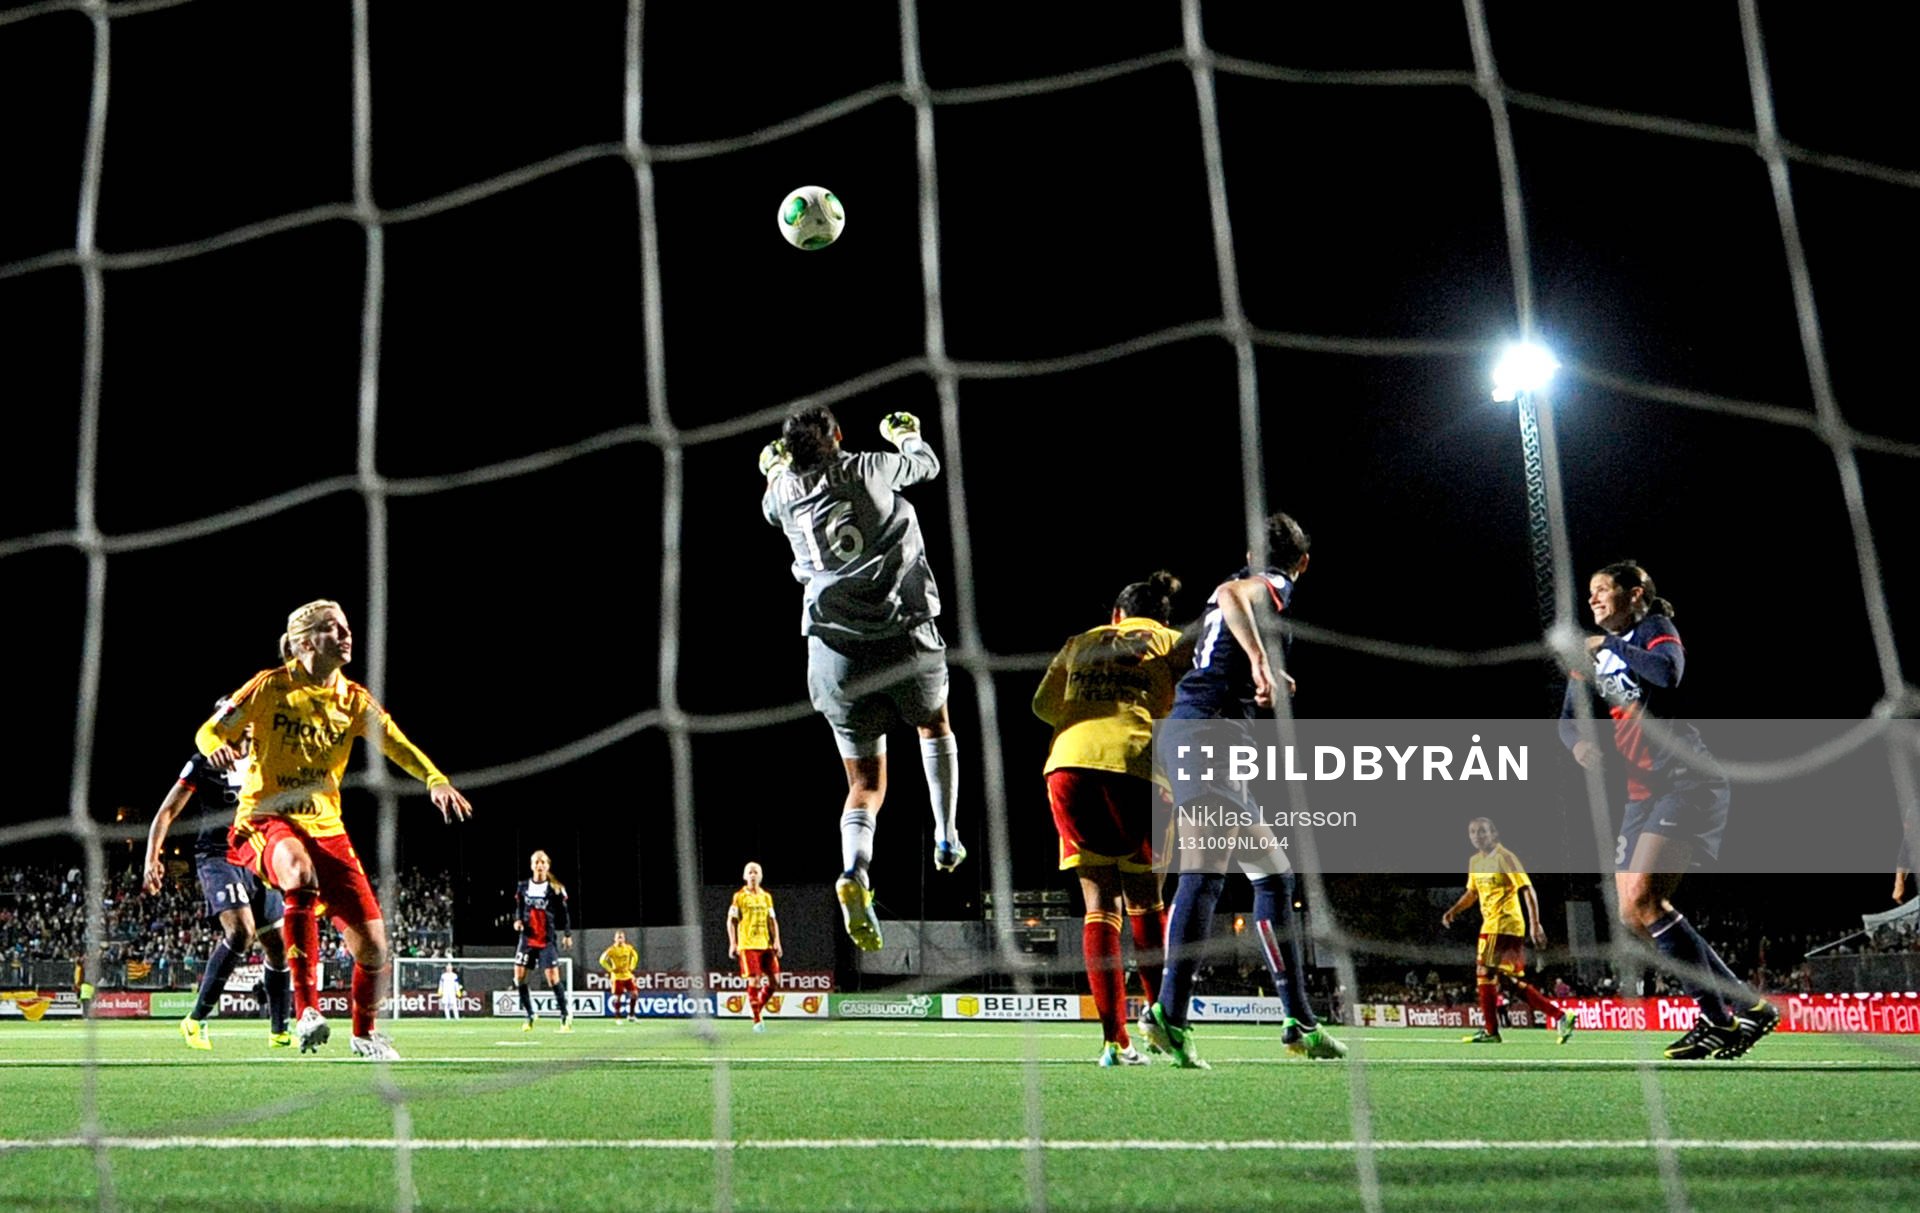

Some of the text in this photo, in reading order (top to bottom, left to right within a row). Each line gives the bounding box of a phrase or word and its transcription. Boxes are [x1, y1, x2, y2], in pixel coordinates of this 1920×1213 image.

[586, 973, 705, 989] Priet Finans
[780, 973, 831, 989] Finans
[607, 994, 715, 1014] Caverion
[985, 997, 1068, 1011] BEIJER
[1602, 1000, 1646, 1029] Finans
[1788, 997, 1920, 1032] Prioritet Finan
